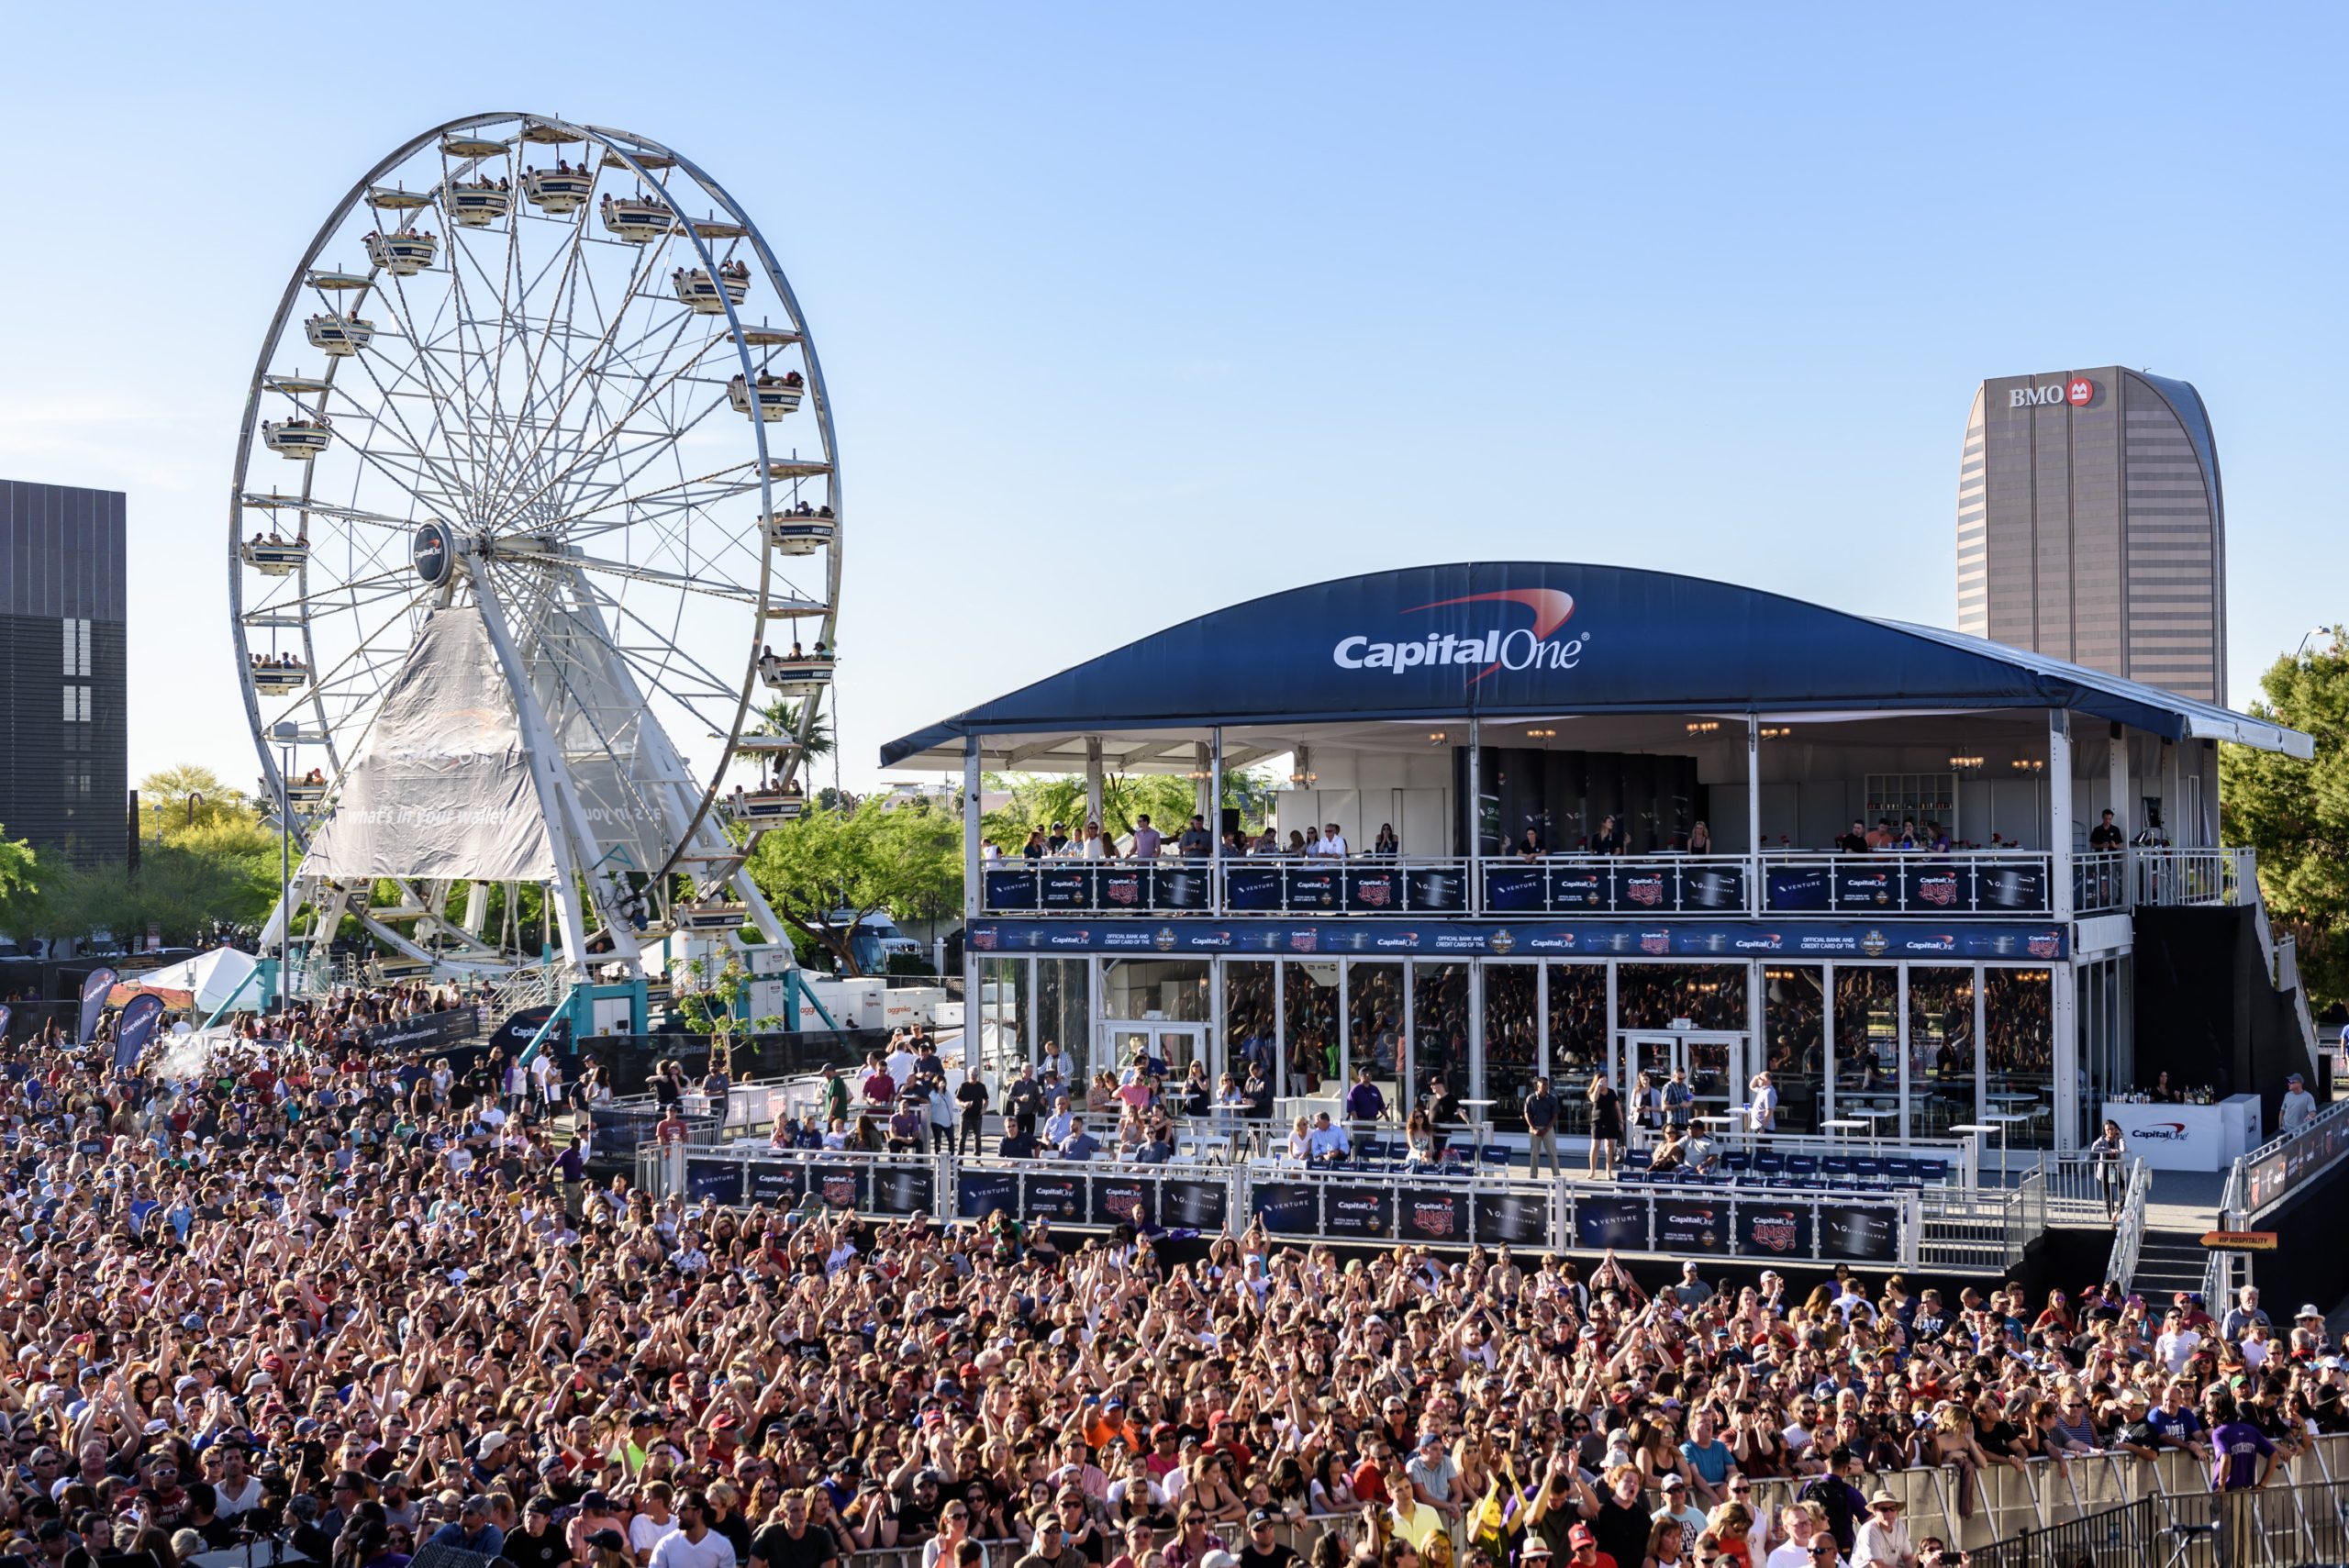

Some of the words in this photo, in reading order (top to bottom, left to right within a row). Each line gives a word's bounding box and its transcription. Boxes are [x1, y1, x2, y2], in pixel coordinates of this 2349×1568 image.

[2009, 385, 2064, 407] BMO
[396, 807, 412, 823] in
[1003, 882, 1030, 892] VENTURE
[1246, 882, 1275, 892] VENTURE
[1507, 882, 1537, 892] VENTURE
[1787, 881, 1820, 891] VENTURE
[800, 1006, 829, 1016] aggro
[887, 1006, 912, 1015] aggreko
[706, 1174, 735, 1184] VENTURE
[978, 1187, 1009, 1196] VENTURE
[1275, 1199, 1308, 1210] VENTURE
[1599, 1215, 1638, 1226] VENTURE
[1840, 1224, 1887, 1240] QUICKSILVER
[2219, 1236, 2229, 1244] VIP
[2230, 1236, 2268, 1245] HOSPITALITY
